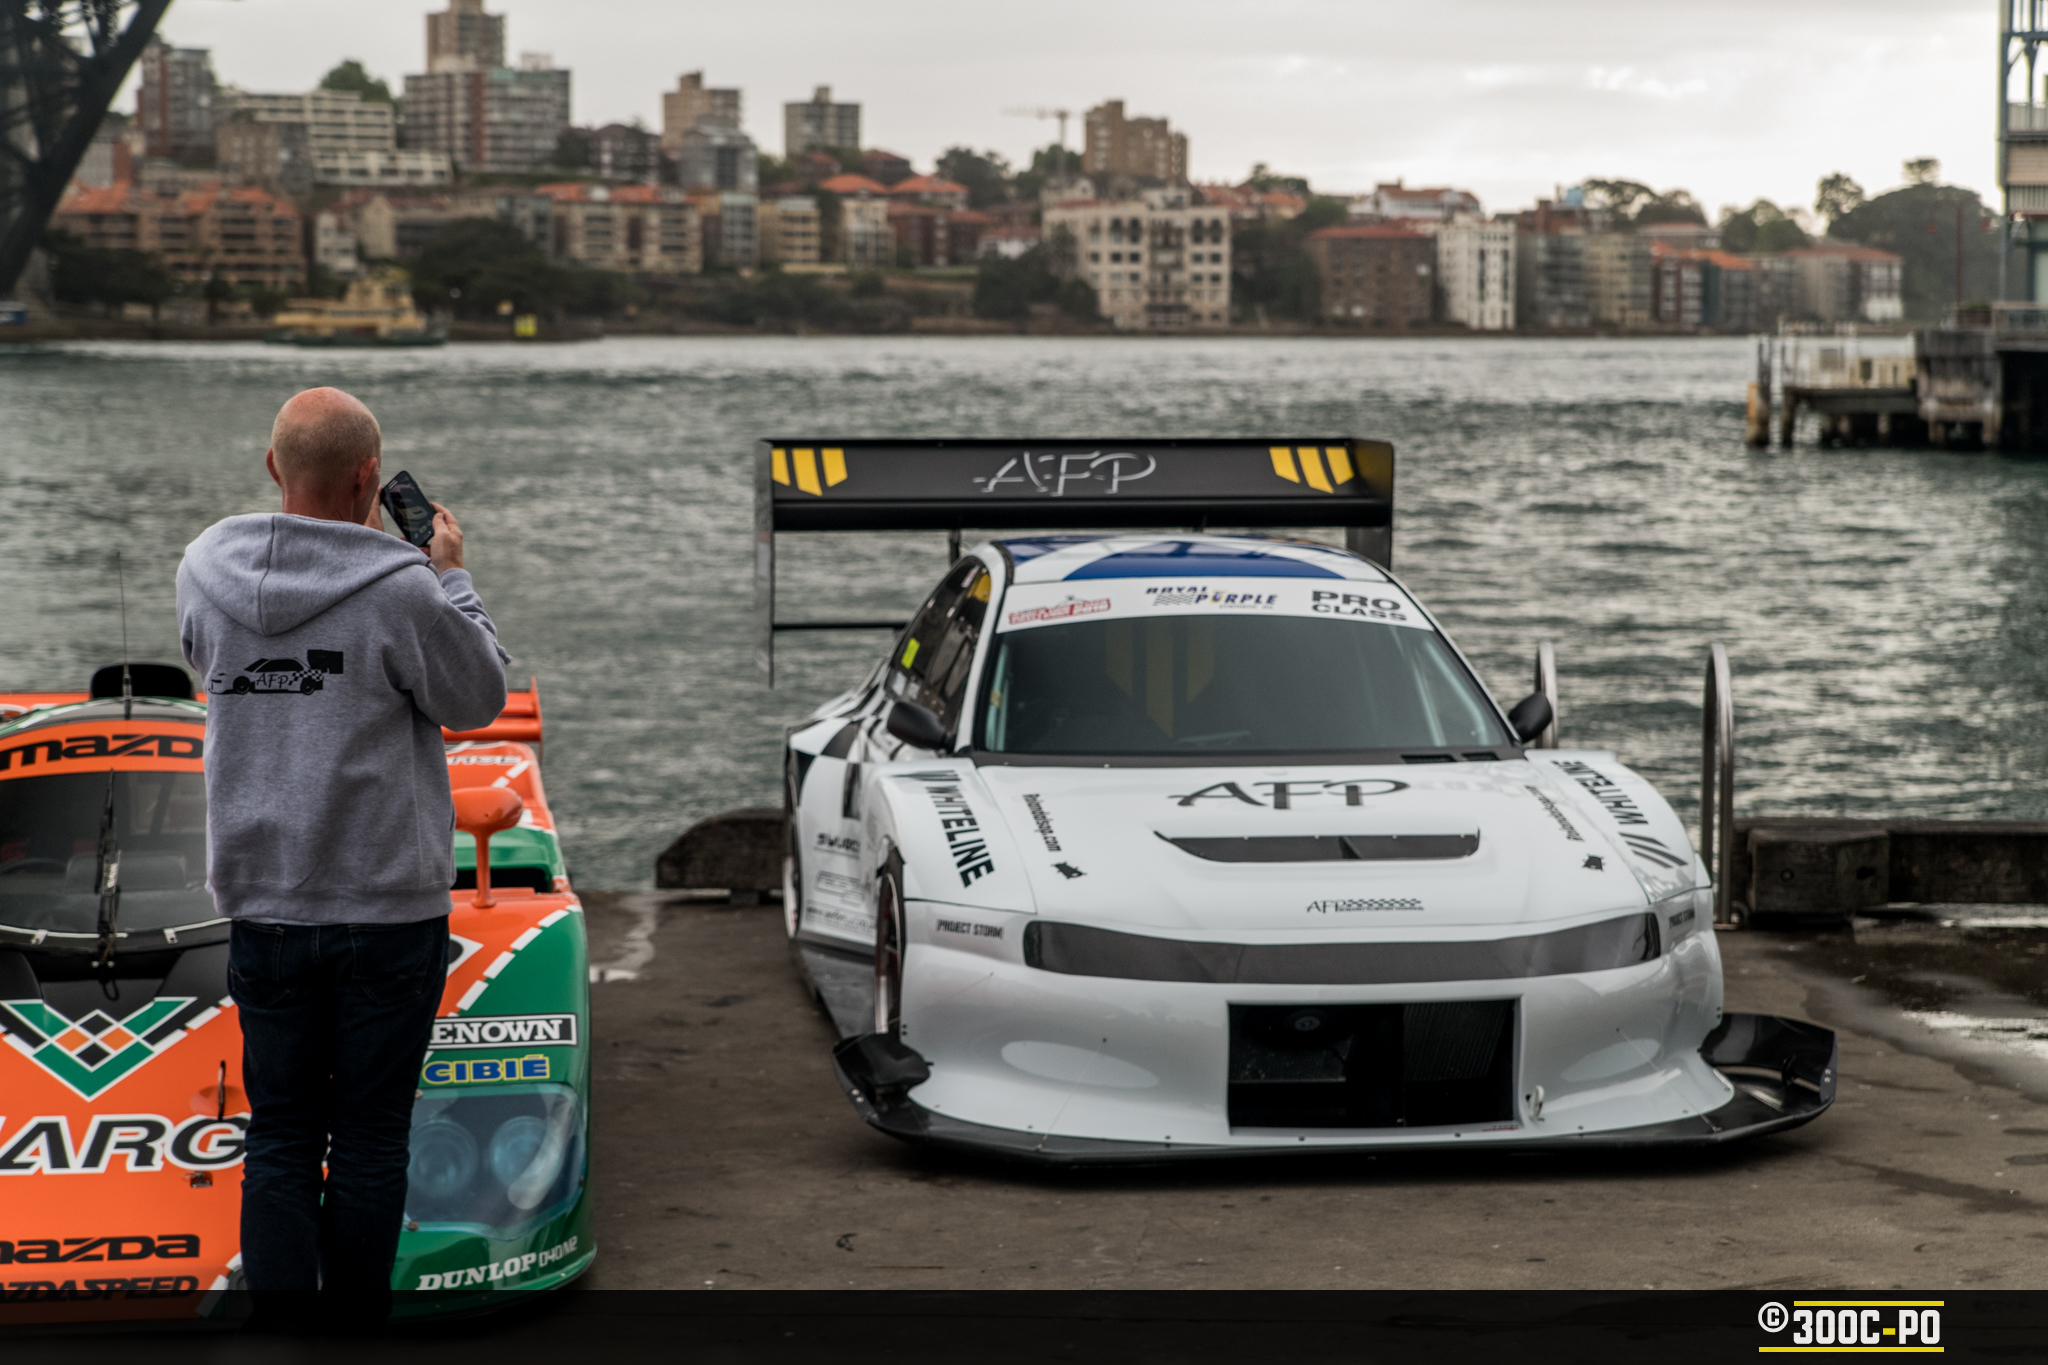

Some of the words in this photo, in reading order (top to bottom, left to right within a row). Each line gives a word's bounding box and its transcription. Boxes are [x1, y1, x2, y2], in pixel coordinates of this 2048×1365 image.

[973, 451, 1157, 497] AFP
[1194, 590, 1278, 605] PURPLE
[1312, 591, 1401, 611] PRO
[1312, 604, 1407, 621] CLASS
[255, 672, 290, 689] AFP
[1167, 779, 1410, 810] AFP
[1551, 760, 1649, 825] WHITELINE
[925, 785, 994, 888] WHITELINE
[1305, 899, 1346, 913] AFP
[937, 919, 971, 935] PROJECT
[974, 923, 1004, 939] STORM
[430, 1019, 563, 1045] ENOWN
[0, 1112, 251, 1175] ARG
[416, 1252, 537, 1290] DUNLOP
